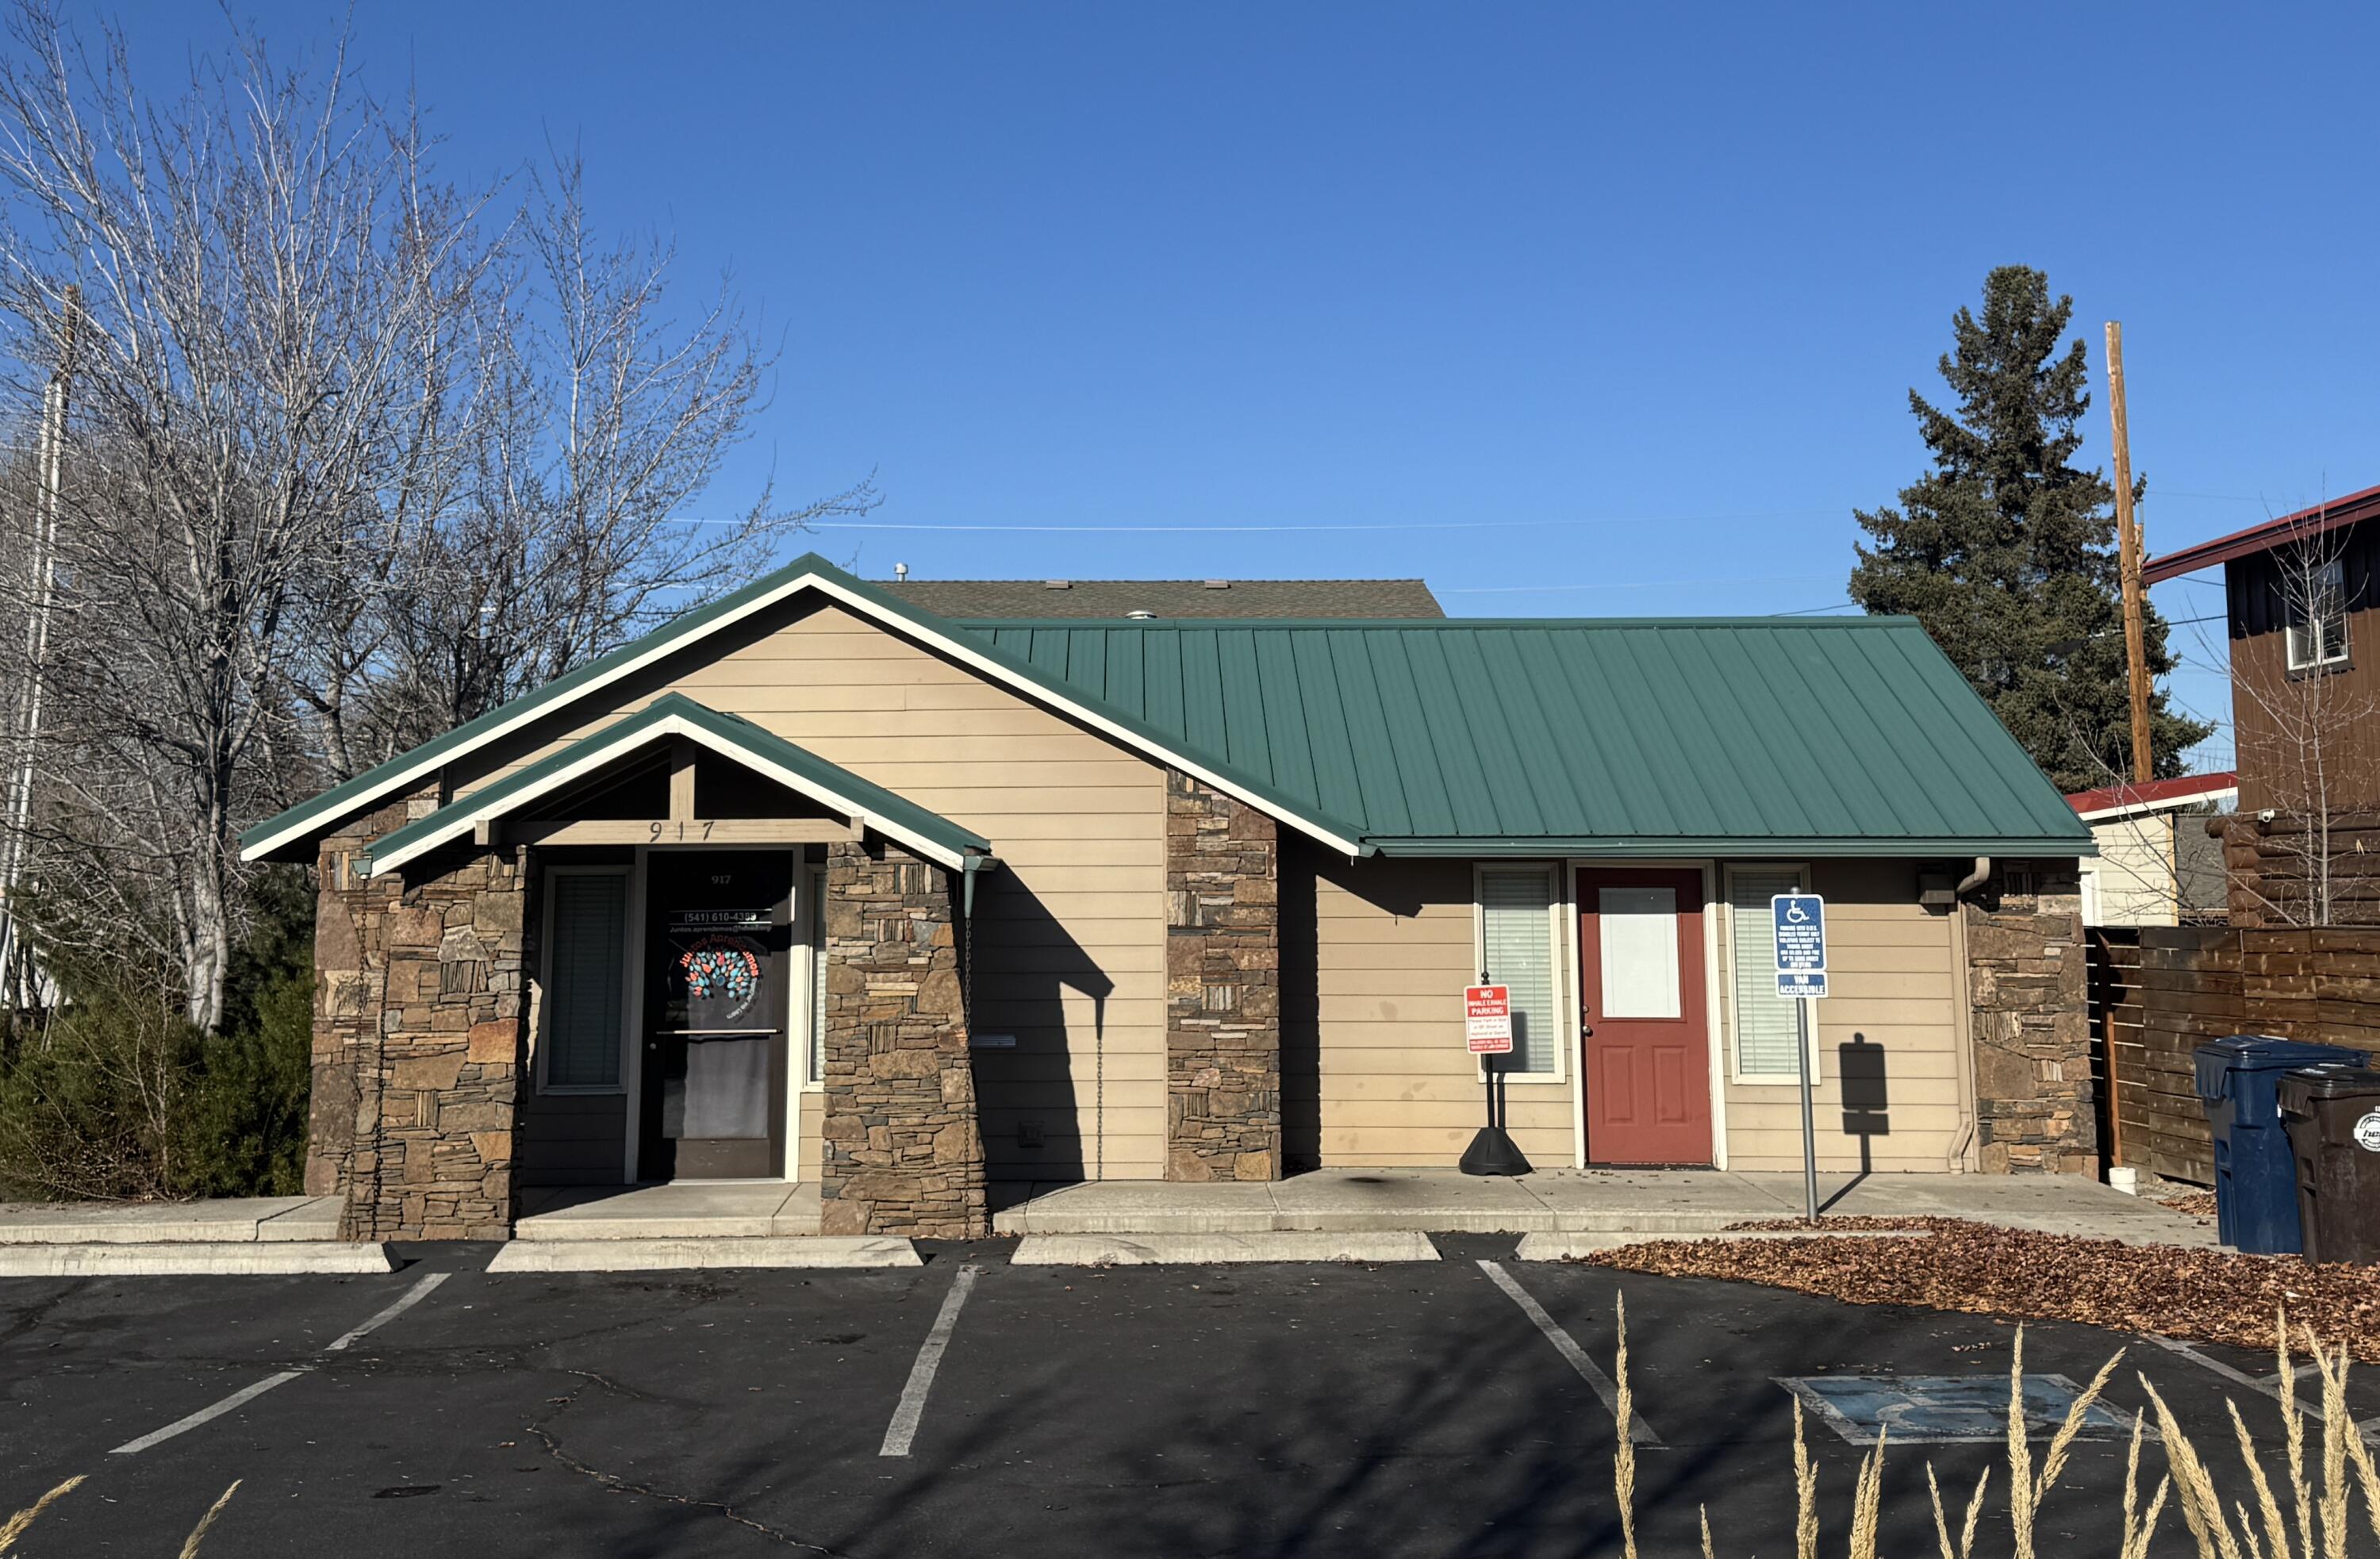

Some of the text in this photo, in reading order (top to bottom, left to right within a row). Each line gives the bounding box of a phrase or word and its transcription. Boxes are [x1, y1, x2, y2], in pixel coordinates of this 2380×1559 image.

[650, 821, 715, 843] 917
[712, 875, 731, 885] 917
[685, 912, 709, 923] (541)
[1794, 975, 1809, 984] VAN
[1480, 989, 1493, 998] NO
[1779, 985, 1825, 994] ACCESSIBLE
